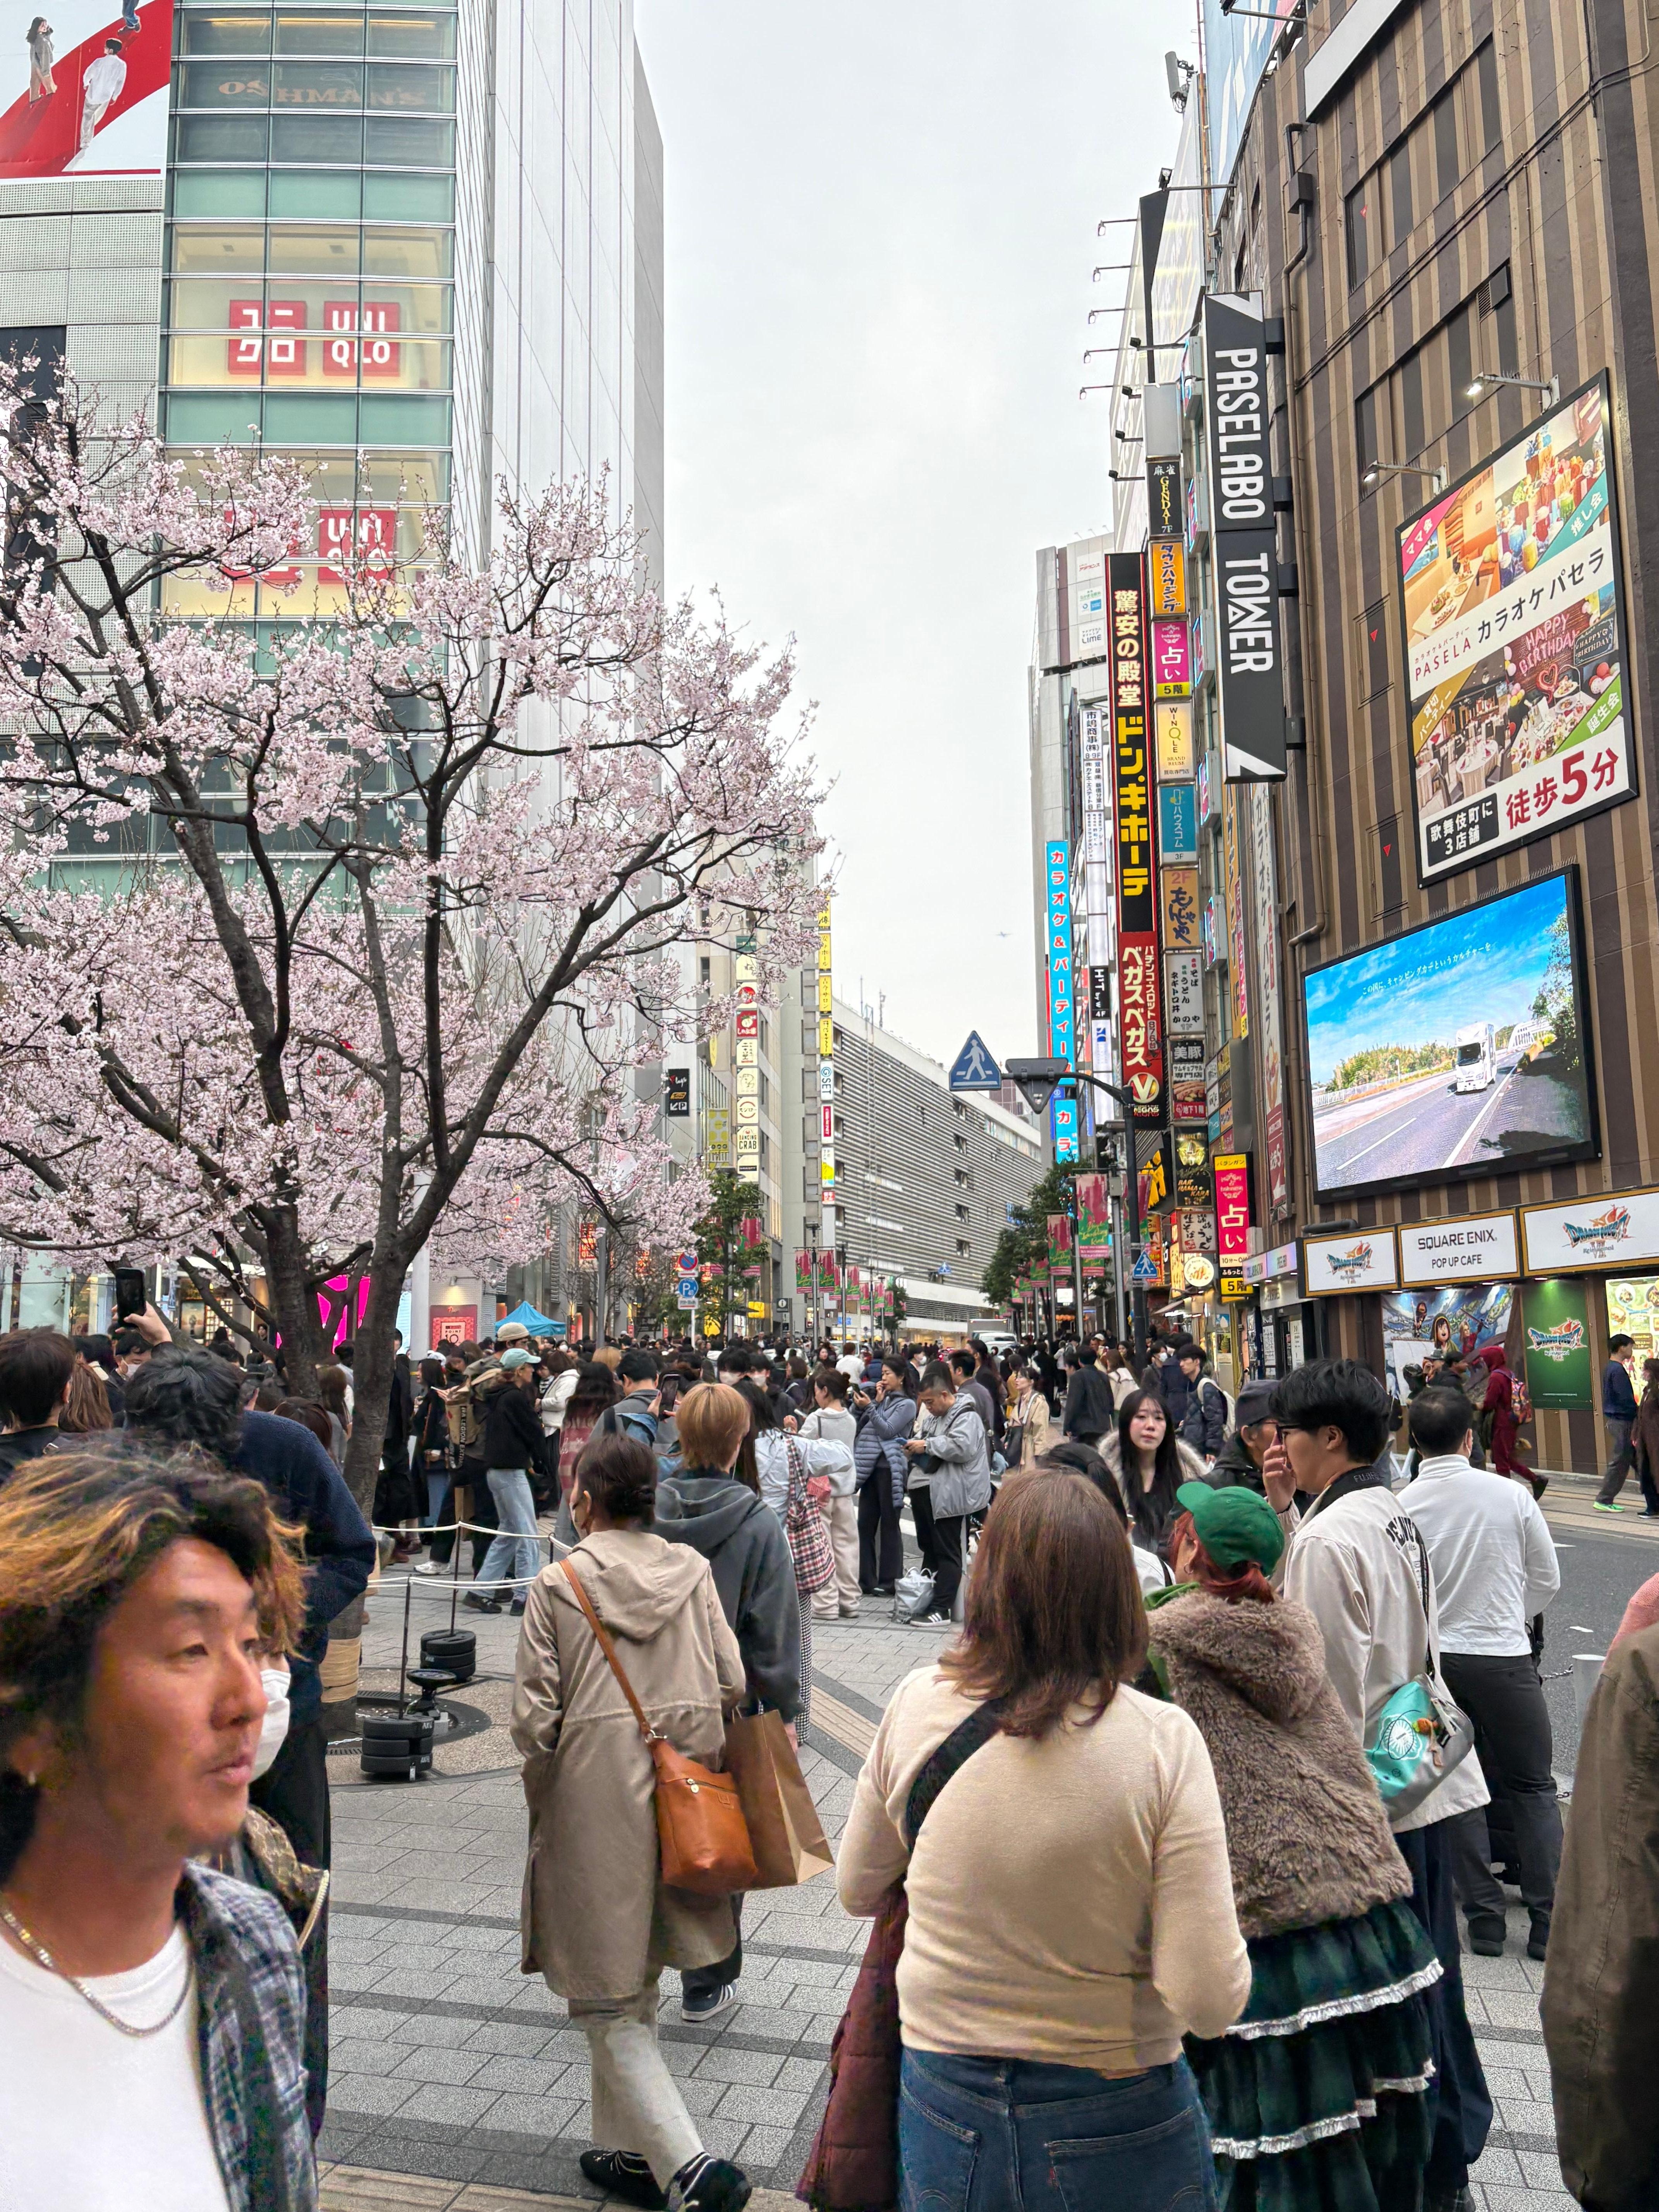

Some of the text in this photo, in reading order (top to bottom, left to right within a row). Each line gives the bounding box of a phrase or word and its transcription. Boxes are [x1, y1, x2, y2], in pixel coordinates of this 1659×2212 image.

[219, 79, 426, 106] OSHMAN'S
[240, 309, 295, 330] ユニ
[332, 311, 386, 332] UNI
[237, 339, 295, 363] クロ
[331, 341, 390, 365] QLO
[1154, 464, 1176, 476] 麻雀
[1160, 476, 1171, 525] GENDAI
[1215, 348, 1273, 674] PASELABO TOWER
[1570, 491, 1603, 537] 推し会
[328, 518, 381, 543] UNI
[1406, 518, 1434, 555] ママ会
[1160, 545, 1181, 612] タウンハウジング
[1478, 547, 1605, 643] カラオケパセラ
[1082, 634, 1102, 644] LIME
[1114, 590, 1141, 707] 驚安の殿堂
[1161, 646, 1185, 680] 占い
[1415, 637, 1471, 681] PASELA
[1164, 684, 1183, 695] 5階
[1420, 690, 1451, 741] パーティー
[1587, 691, 1620, 734] 誕生会
[1506, 748, 1619, 830] 徒歩5分
[1173, 805, 1183, 847] ハウスコム
[1430, 800, 1493, 843] 歌舞伎町に
[1445, 825, 1480, 855] 3店舗
[1171, 872, 1192, 884] 2F
[1145, 945, 1156, 1019] パチンコ・スロット
[1181, 977, 1190, 1004] うどん
[1190, 969, 1199, 986] そば
[1122, 946, 1147, 1066] ベガスベガス
[1172, 1015, 1200, 1023] かのや
[1174, 1046, 1202, 1060] 美豚
[739, 1140, 757, 1150] CRAB
[1220, 1204, 1247, 1248] 占い
[1418, 1229, 1496, 1250] SQUARE ENIX
[1432, 1254, 1482, 1268] POP UP CAFE
